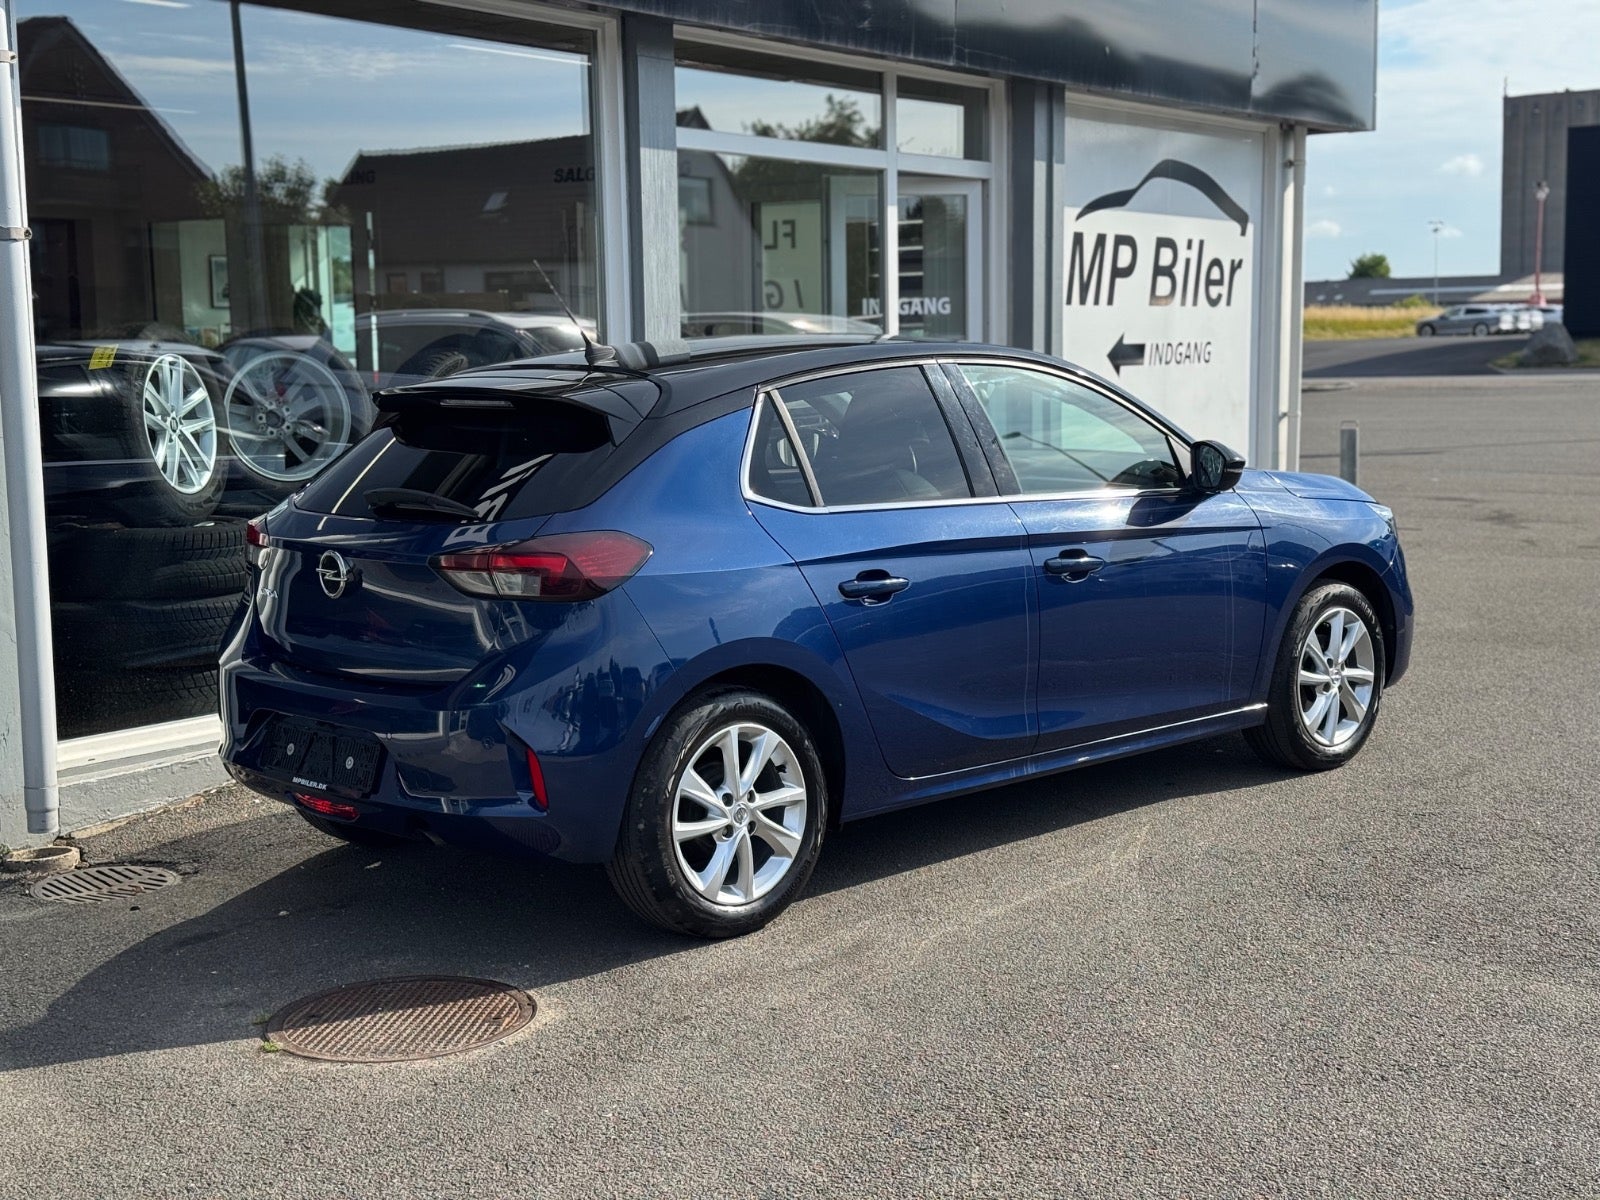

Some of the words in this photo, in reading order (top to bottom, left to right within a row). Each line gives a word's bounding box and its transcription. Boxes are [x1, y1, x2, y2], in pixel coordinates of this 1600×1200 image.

[1066, 231, 1138, 306] MP
[1150, 237, 1243, 307] Biler
[861, 297, 952, 316] INGANG
[1148, 341, 1212, 366] INDGANG
[291, 776, 328, 791] MPBILER.DK
